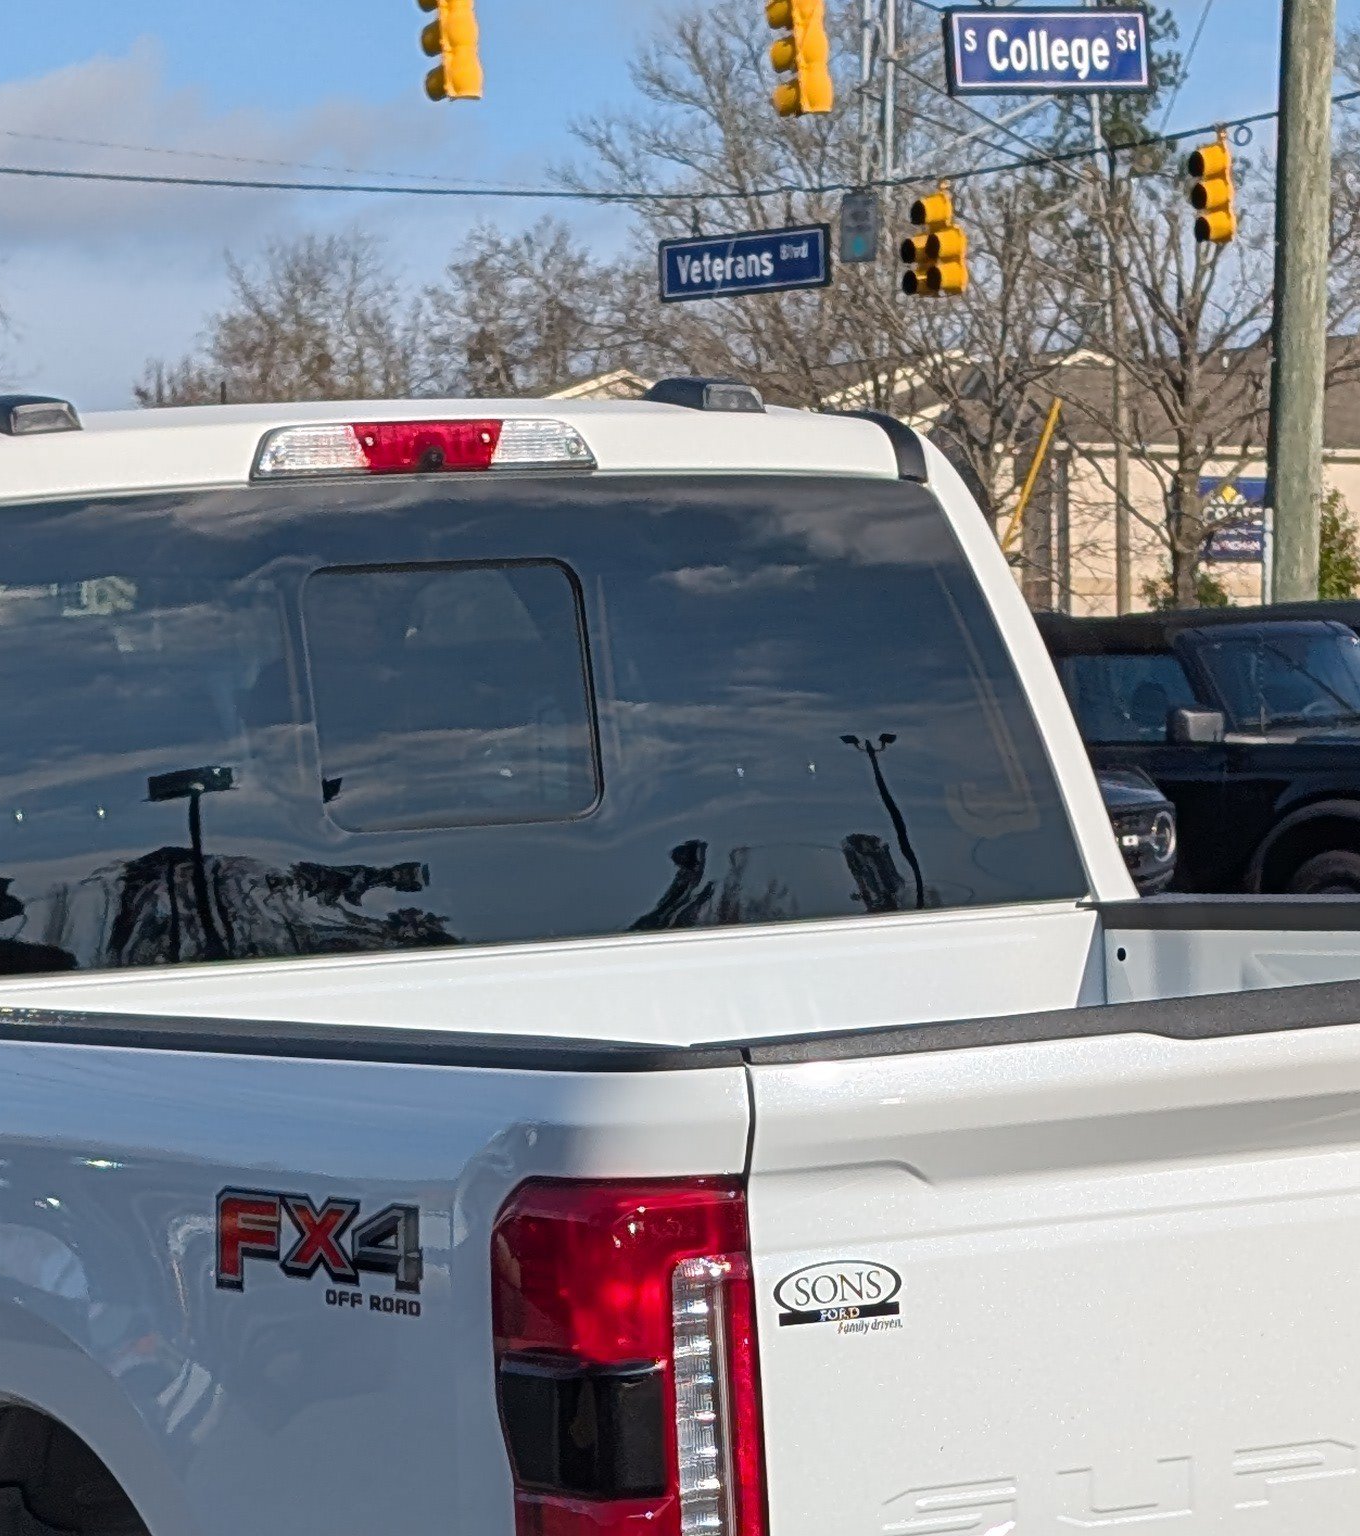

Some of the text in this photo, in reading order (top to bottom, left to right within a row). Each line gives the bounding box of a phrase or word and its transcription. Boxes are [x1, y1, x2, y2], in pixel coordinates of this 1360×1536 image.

[964, 28, 1137, 80] S College St
[676, 252, 775, 285] Veterans
[215, 1184, 423, 1295] FX4
[325, 1289, 421, 1317] OFF ROAD
[794, 1270, 882, 1307] SONS
[820, 1306, 861, 1321] FORD
